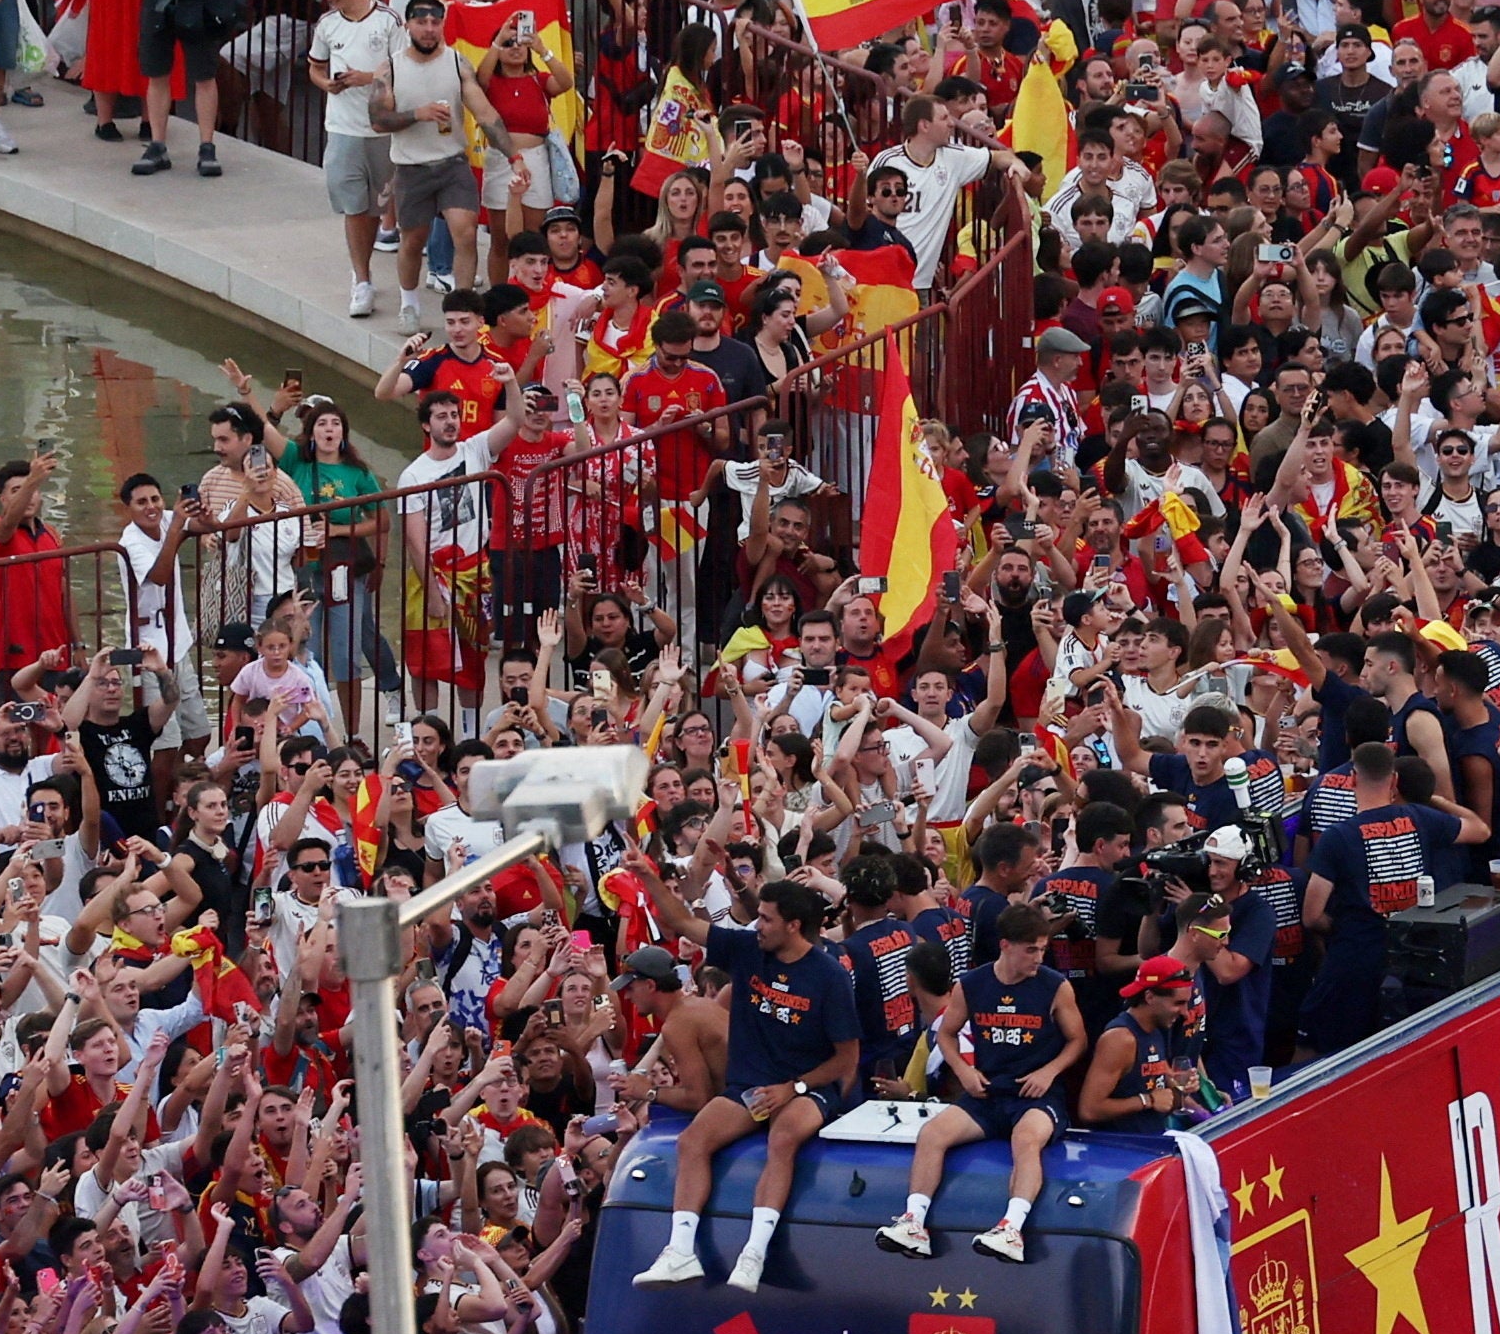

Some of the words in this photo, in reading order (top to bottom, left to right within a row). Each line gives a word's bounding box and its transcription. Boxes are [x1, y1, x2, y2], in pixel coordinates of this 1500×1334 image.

[902, 191, 922, 213] 21
[463, 399, 478, 424] 19
[1321, 773, 1358, 790] ESPA
[106, 784, 151, 804] ENEMY
[1361, 816, 1415, 839] ESPAÑA
[1046, 879, 1098, 899] ESPAÑA
[868, 933, 913, 955] ESPAÑA
[749, 975, 811, 1011] CAMPEONES
[975, 1011, 1043, 1028] CAMPEONES
